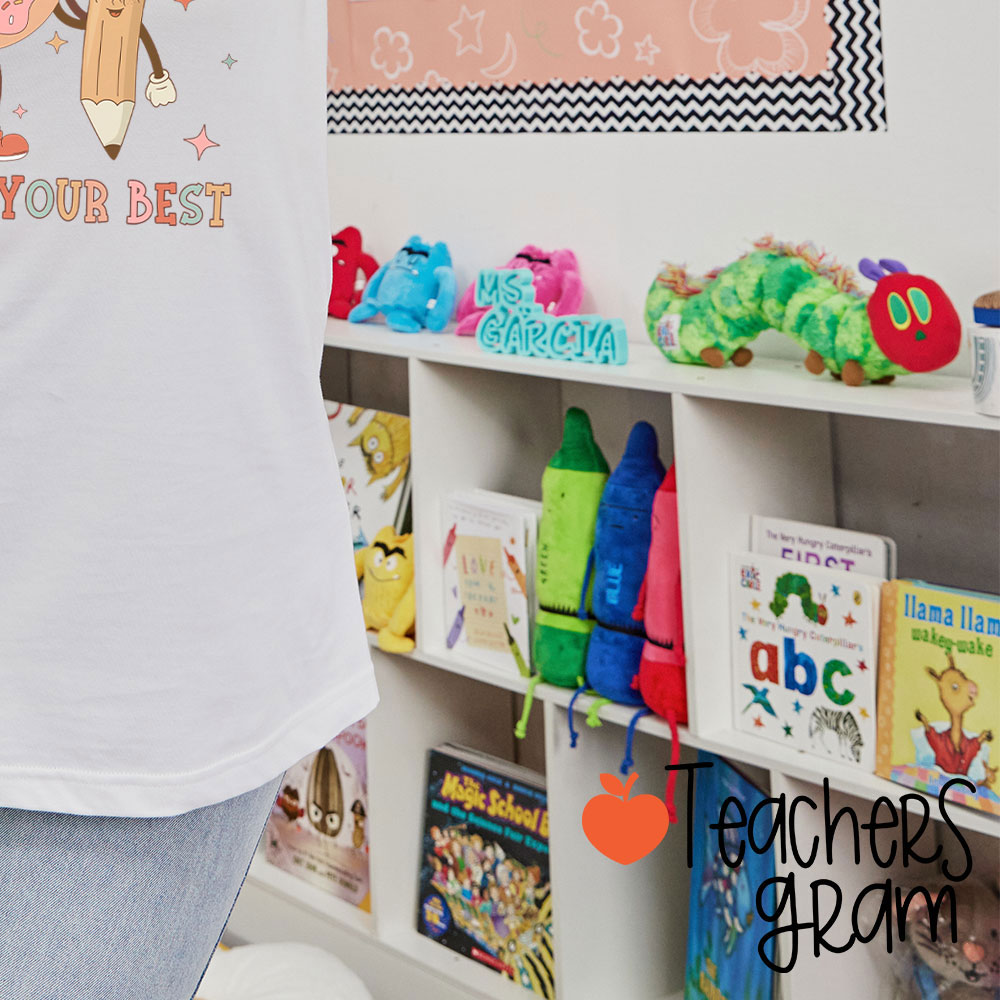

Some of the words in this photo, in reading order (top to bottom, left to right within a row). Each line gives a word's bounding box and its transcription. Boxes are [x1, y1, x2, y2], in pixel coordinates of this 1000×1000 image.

[127, 180, 232, 228] BEST
[478, 310, 618, 362] GARCIA
[904, 593, 954, 628] llama
[750, 637, 855, 706] abc
[441, 771, 487, 811] Magic
[487, 788, 541, 834] School
